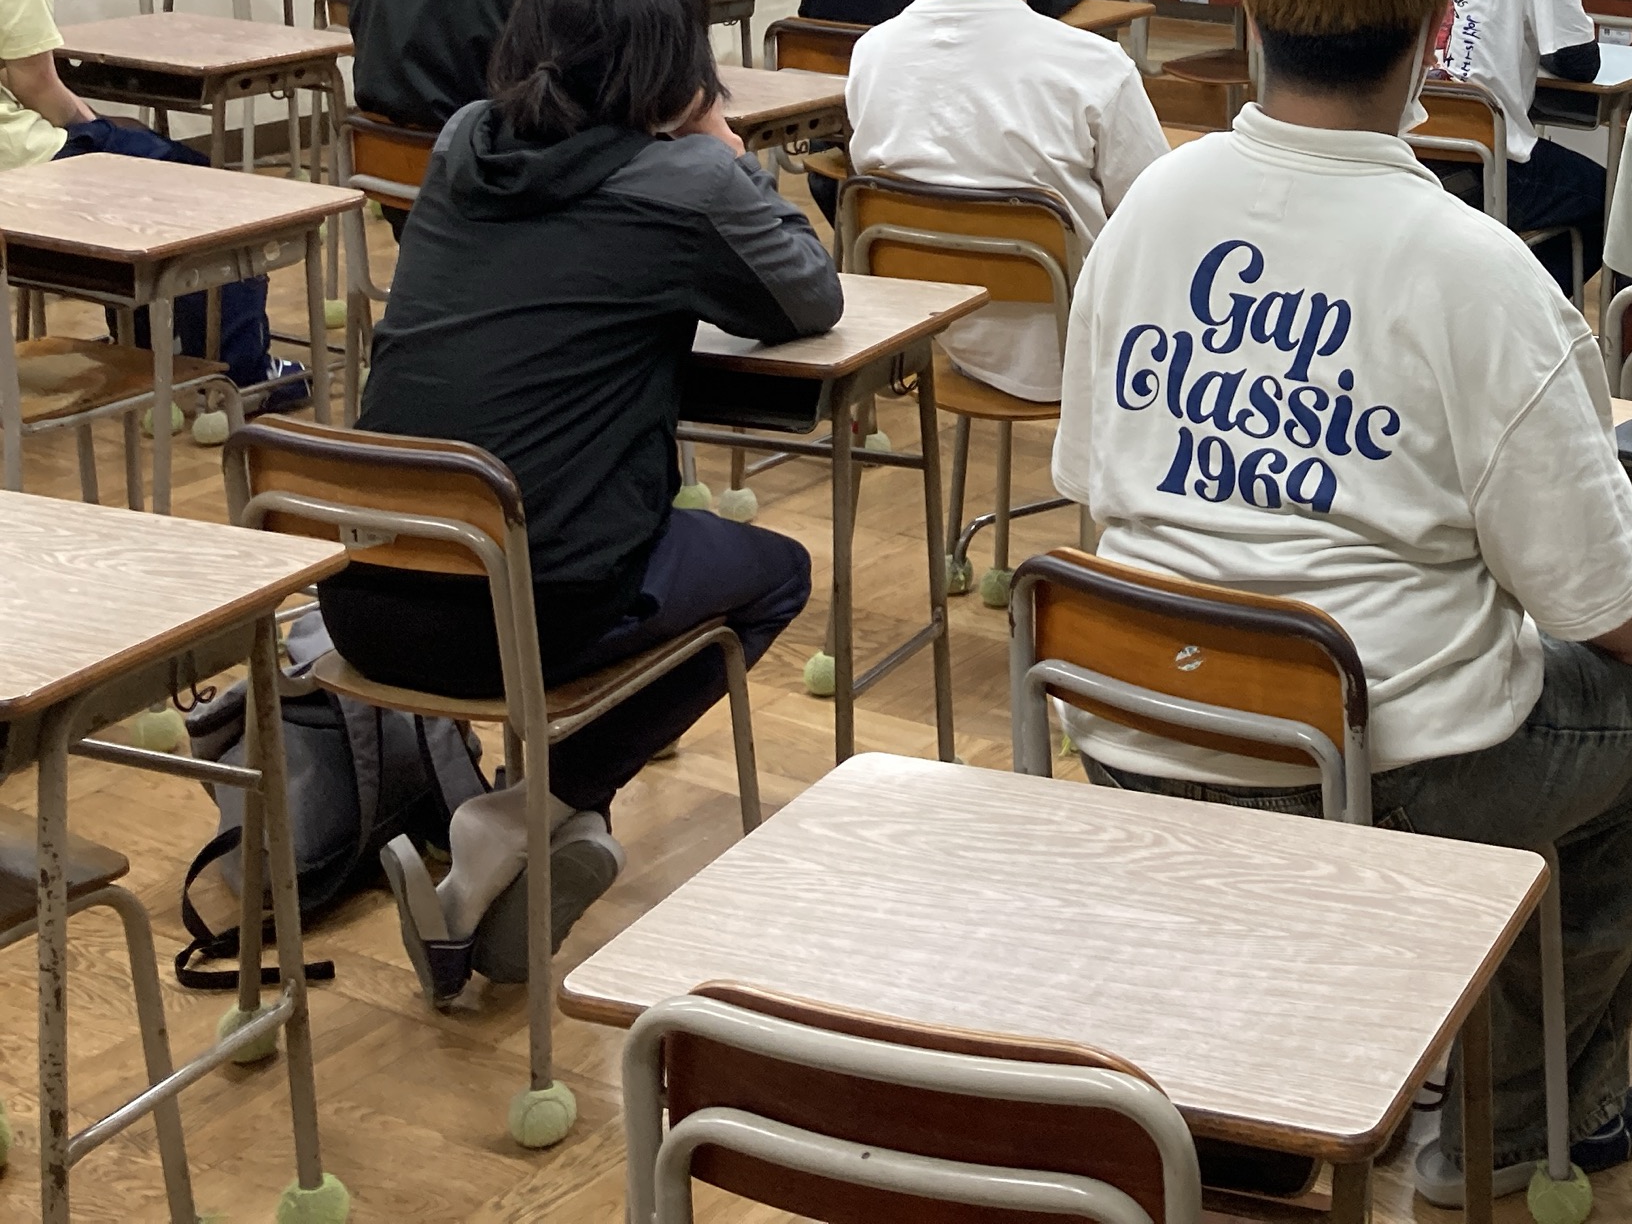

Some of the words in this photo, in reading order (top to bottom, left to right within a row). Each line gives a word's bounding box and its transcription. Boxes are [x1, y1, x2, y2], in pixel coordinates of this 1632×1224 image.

[1189, 239, 1352, 382] Gap
[1116, 324, 1401, 461] Classic
[1156, 426, 1338, 514] 1969
